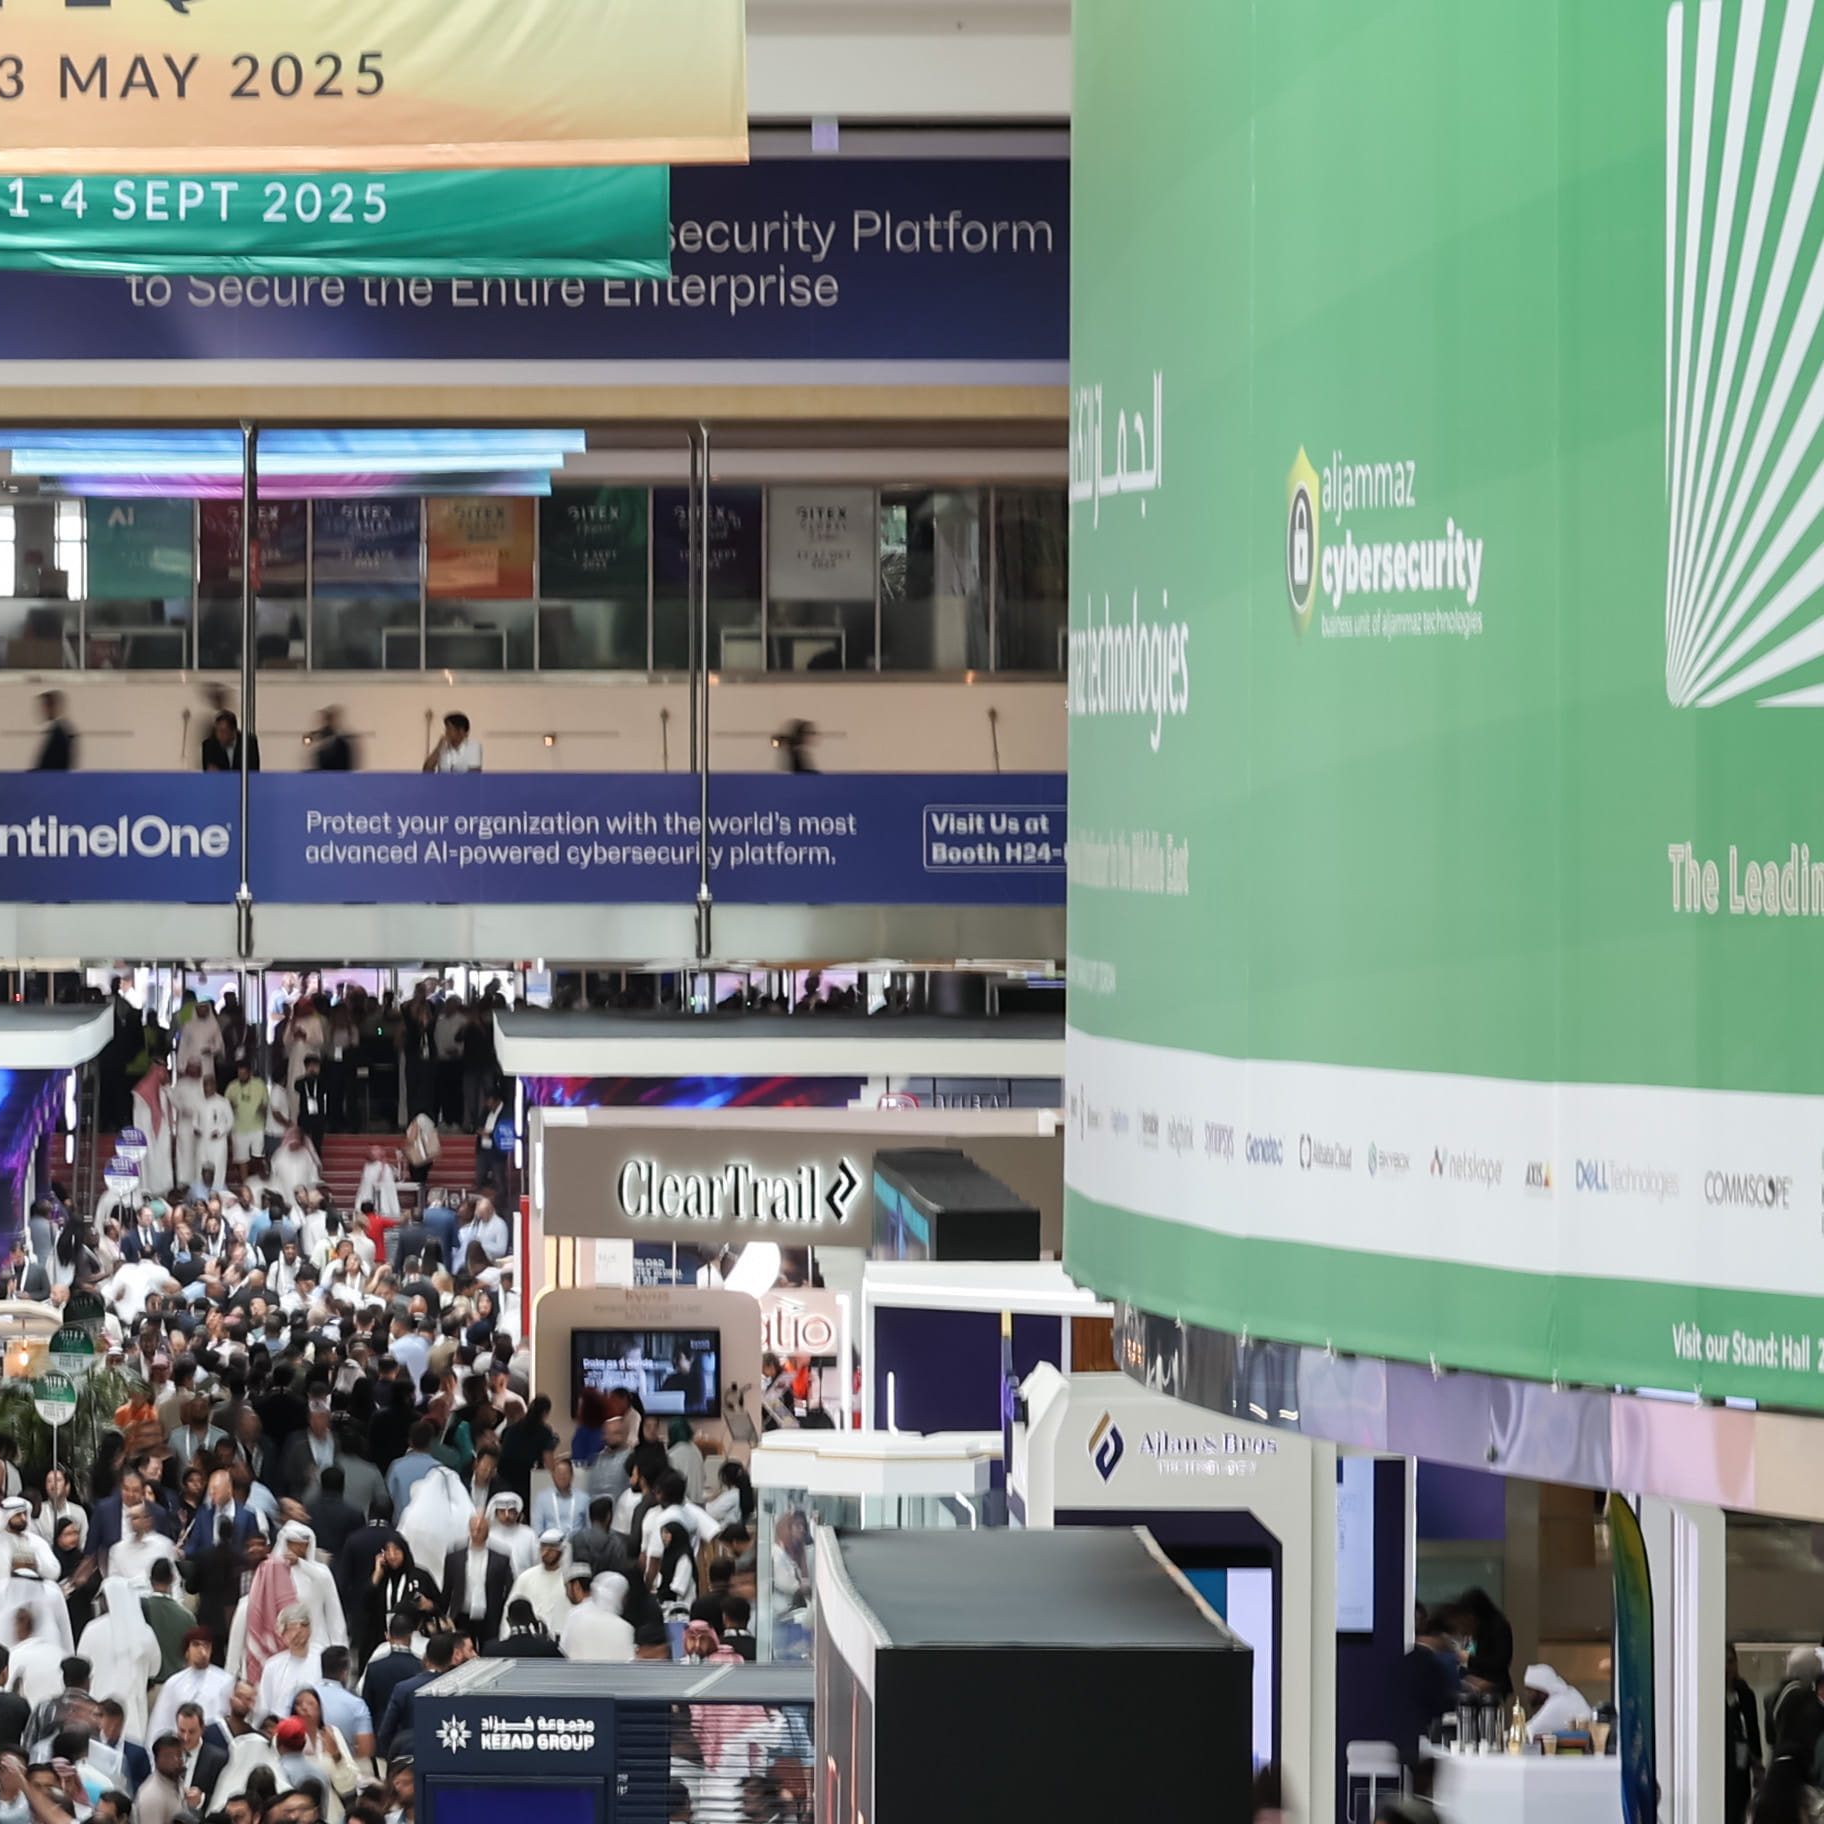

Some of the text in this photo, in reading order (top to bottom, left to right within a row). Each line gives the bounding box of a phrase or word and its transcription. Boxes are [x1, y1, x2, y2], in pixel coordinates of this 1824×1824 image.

[57, 53, 202, 100] MAY
[229, 51, 386, 98] 2025
[7, 178, 388, 226] 1-4 SEPT 2025
[852, 209, 1053, 255] Platform
[126, 266, 838, 316] to Secure the Enterprise
[1321, 451, 1417, 525] aljammaz
[1320, 516, 1484, 611] cybersecurity
[1321, 608, 1483, 642] business aljammaz technologies
[305, 810, 857, 841] Protect your organization with the world's most
[931, 811, 1049, 835] Visit Us at
[305, 840, 837, 870] advanced AI-powered platform.
[931, 840, 1000, 865] Booth
[1668, 842, 1719, 914] The
[616, 1157, 824, 1224] ClearTrail
[1449, 1152, 1503, 1189] netskope
[1575, 1159, 1680, 1202] DELL Technologies
[1704, 1170, 1791, 1209] COMMSCOPE
[1671, 1321, 1810, 1372] Visit our Stand: Hall
[480, 1733, 596, 1752] KEZAD GROUP
